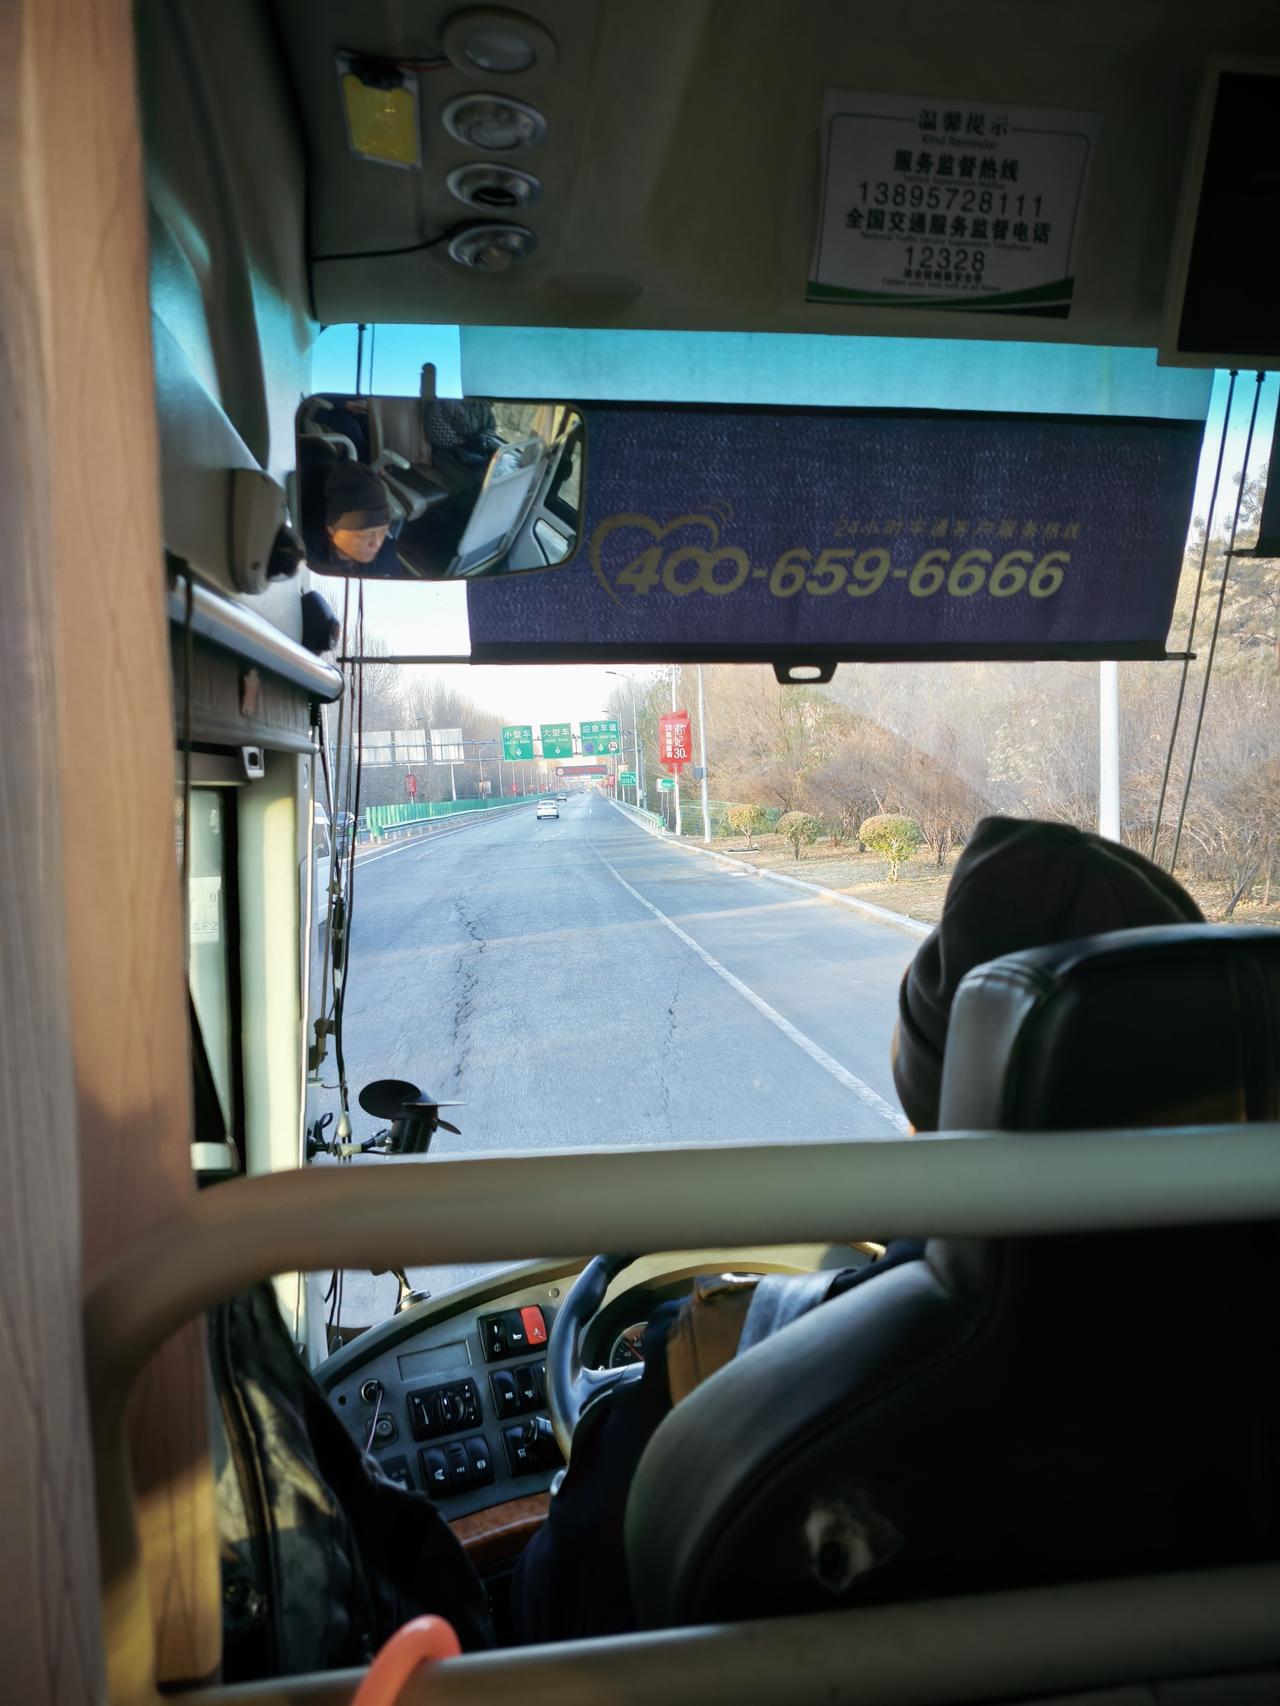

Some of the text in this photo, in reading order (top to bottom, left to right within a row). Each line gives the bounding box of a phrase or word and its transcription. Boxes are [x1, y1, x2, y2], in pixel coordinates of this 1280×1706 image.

[918, 109, 1010, 137] 温馨提示
[894, 149, 1020, 182] 服务监督热线
[858, 180, 1043, 218] 13895728111
[845, 207, 1051, 244] 全国交通服务监督电话
[904, 245, 987, 274] 12328
[616, 545, 1071, 598] 400-659-6666
[504, 729, 531, 739] 小型车
[543, 728, 570, 738] 大型车
[582, 723, 617, 733] 应急车道
